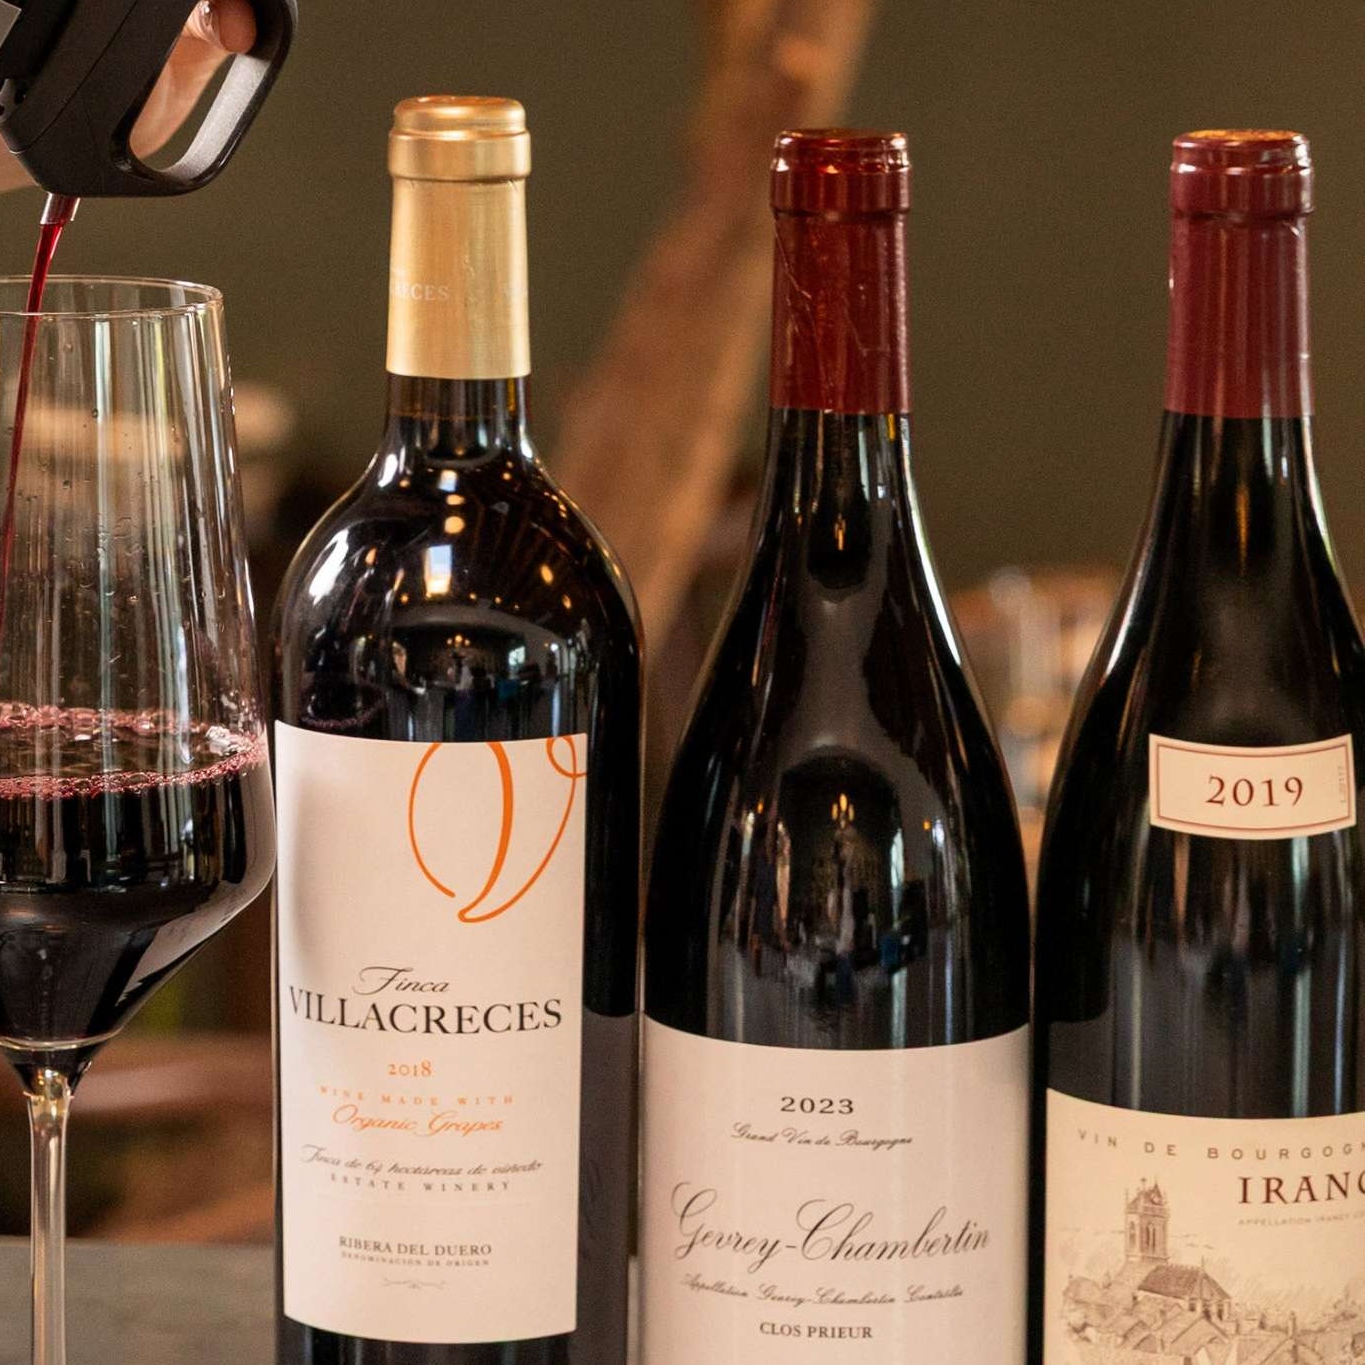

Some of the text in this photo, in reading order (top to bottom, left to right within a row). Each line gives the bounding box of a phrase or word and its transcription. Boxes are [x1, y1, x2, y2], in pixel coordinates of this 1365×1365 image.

[1206, 776, 1304, 808] 2019
[352, 966, 450, 996] Finca
[289, 985, 562, 1035] VILLACRECES
[388, 1060, 433, 1077] 2018
[381, 1094, 439, 1106] MADE
[457, 1095, 514, 1106] WITH
[780, 1096, 854, 1115] 2023
[332, 1104, 503, 1137] Organic Grapes
[1078, 1128, 1117, 1147] VIN
[1144, 1141, 1176, 1156] DE
[331, 1173, 510, 1193] ESTATE WINERY
[671, 1182, 990, 1274] Gevrey-Chambertin
[339, 1235, 492, 1256] RIBERA DEL DUERO
[759, 1322, 874, 1339] CLOS PRIEUR
